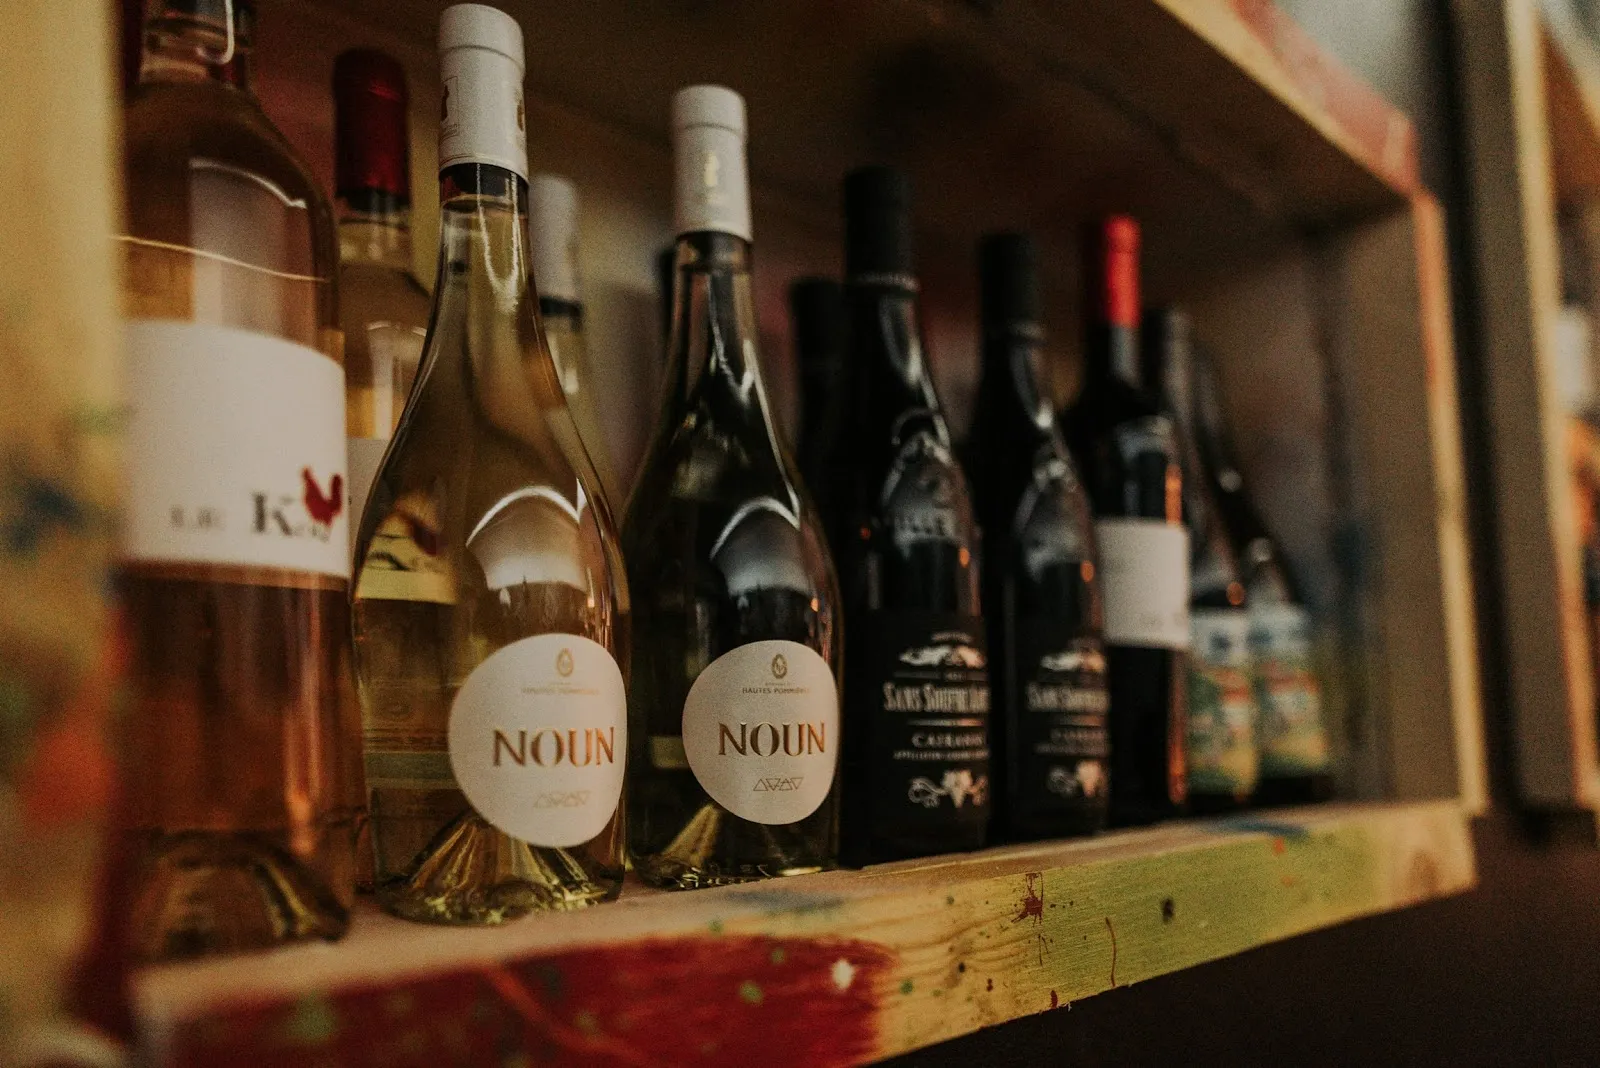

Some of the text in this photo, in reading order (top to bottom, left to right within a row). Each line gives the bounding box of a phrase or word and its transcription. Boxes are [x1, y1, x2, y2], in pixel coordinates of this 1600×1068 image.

[742, 687, 772, 695] HAUTES
[493, 727, 615, 767] NOUN
[718, 721, 825, 757] NOUN
